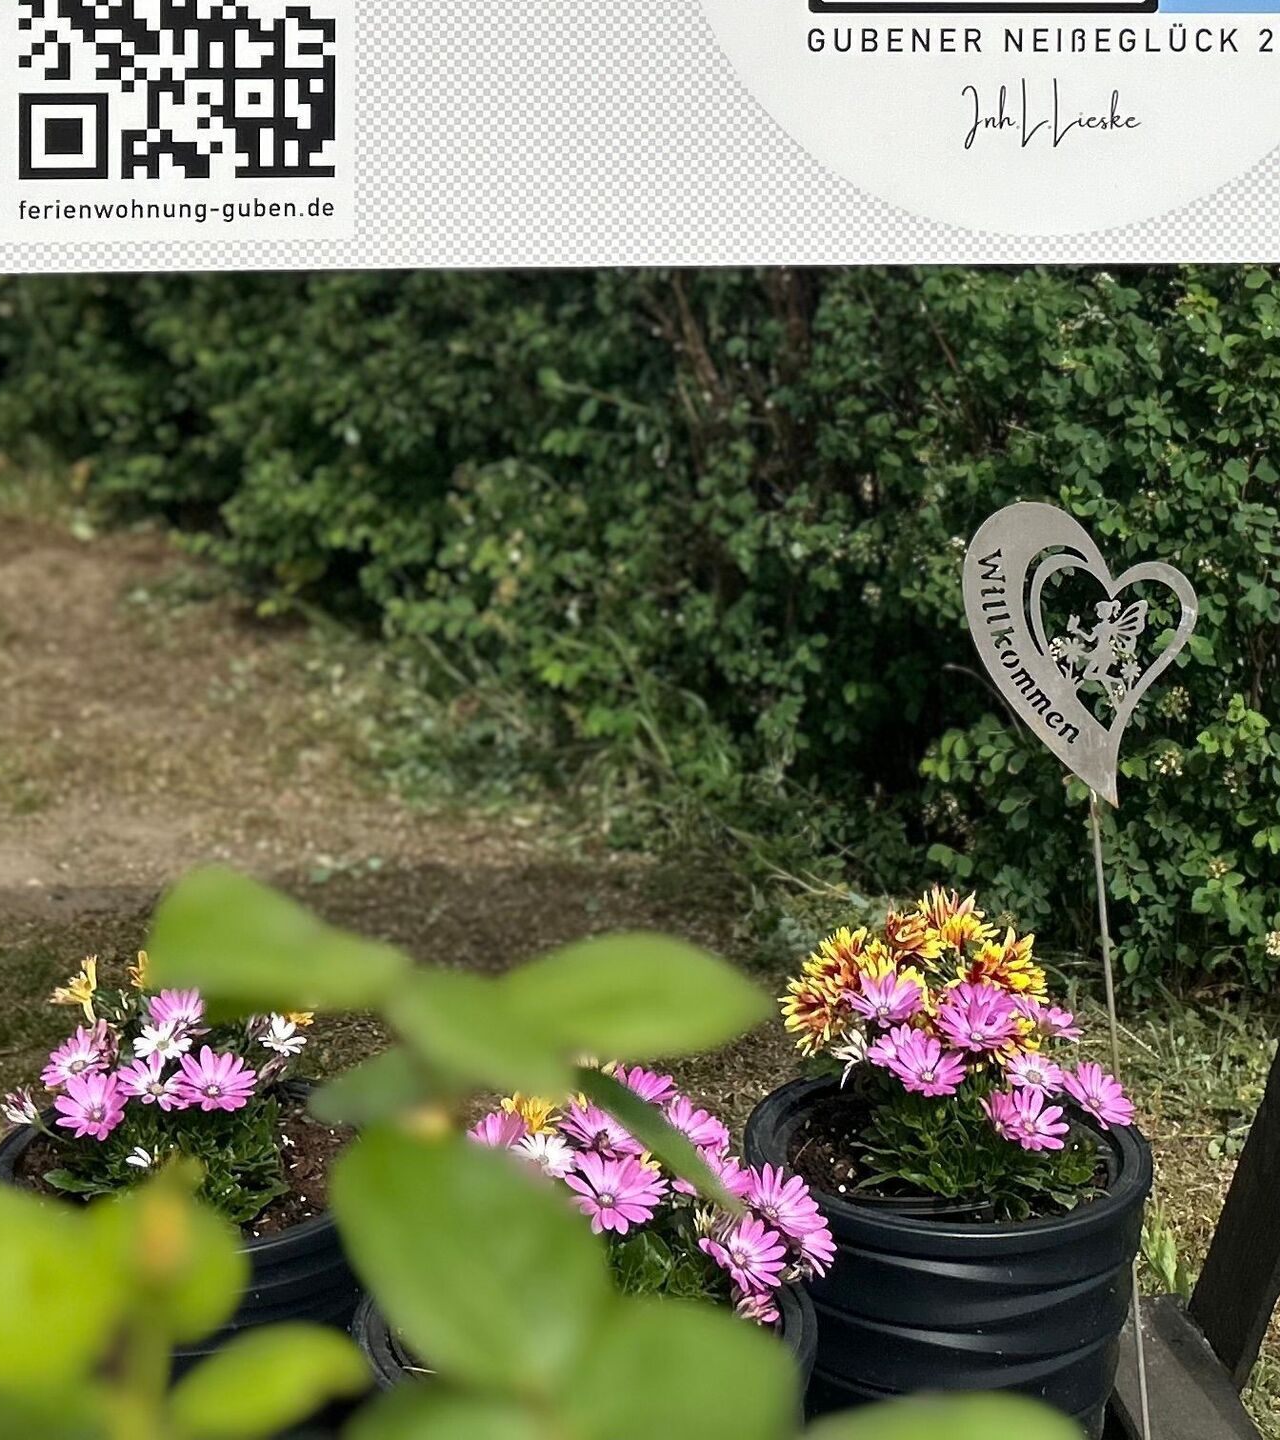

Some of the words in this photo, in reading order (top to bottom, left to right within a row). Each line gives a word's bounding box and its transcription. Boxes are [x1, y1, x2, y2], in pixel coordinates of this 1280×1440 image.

[807, 27, 982, 53] GUBENER
[1053, 77, 1142, 148] Lieske
[18, 197, 335, 223] ferienwohnung-guben.de
[977, 548, 1080, 744] Willkommen
